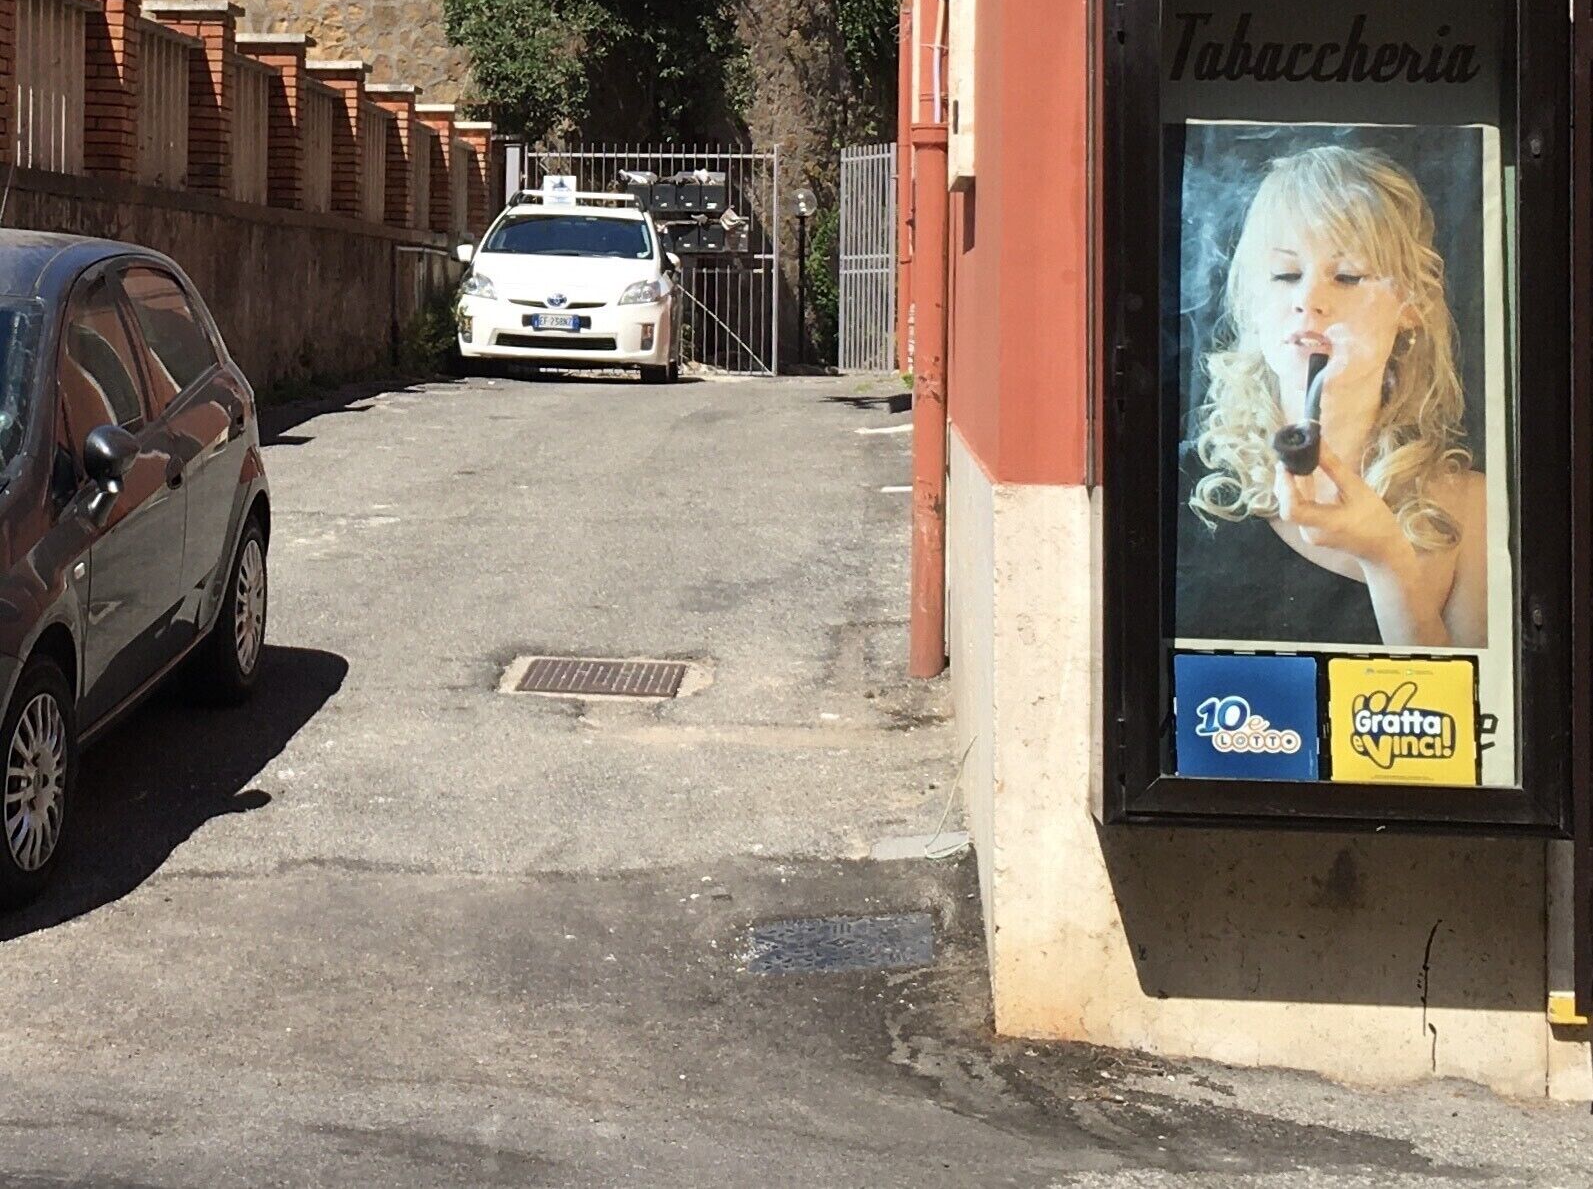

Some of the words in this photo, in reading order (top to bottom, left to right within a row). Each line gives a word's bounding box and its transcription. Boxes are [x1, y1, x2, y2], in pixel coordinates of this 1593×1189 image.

[1170, 11, 1481, 83] Tabaccheria
[1196, 697, 1250, 735] 10
[1355, 709, 1441, 735] Gratta
[1217, 733, 1296, 749] LOTTO
